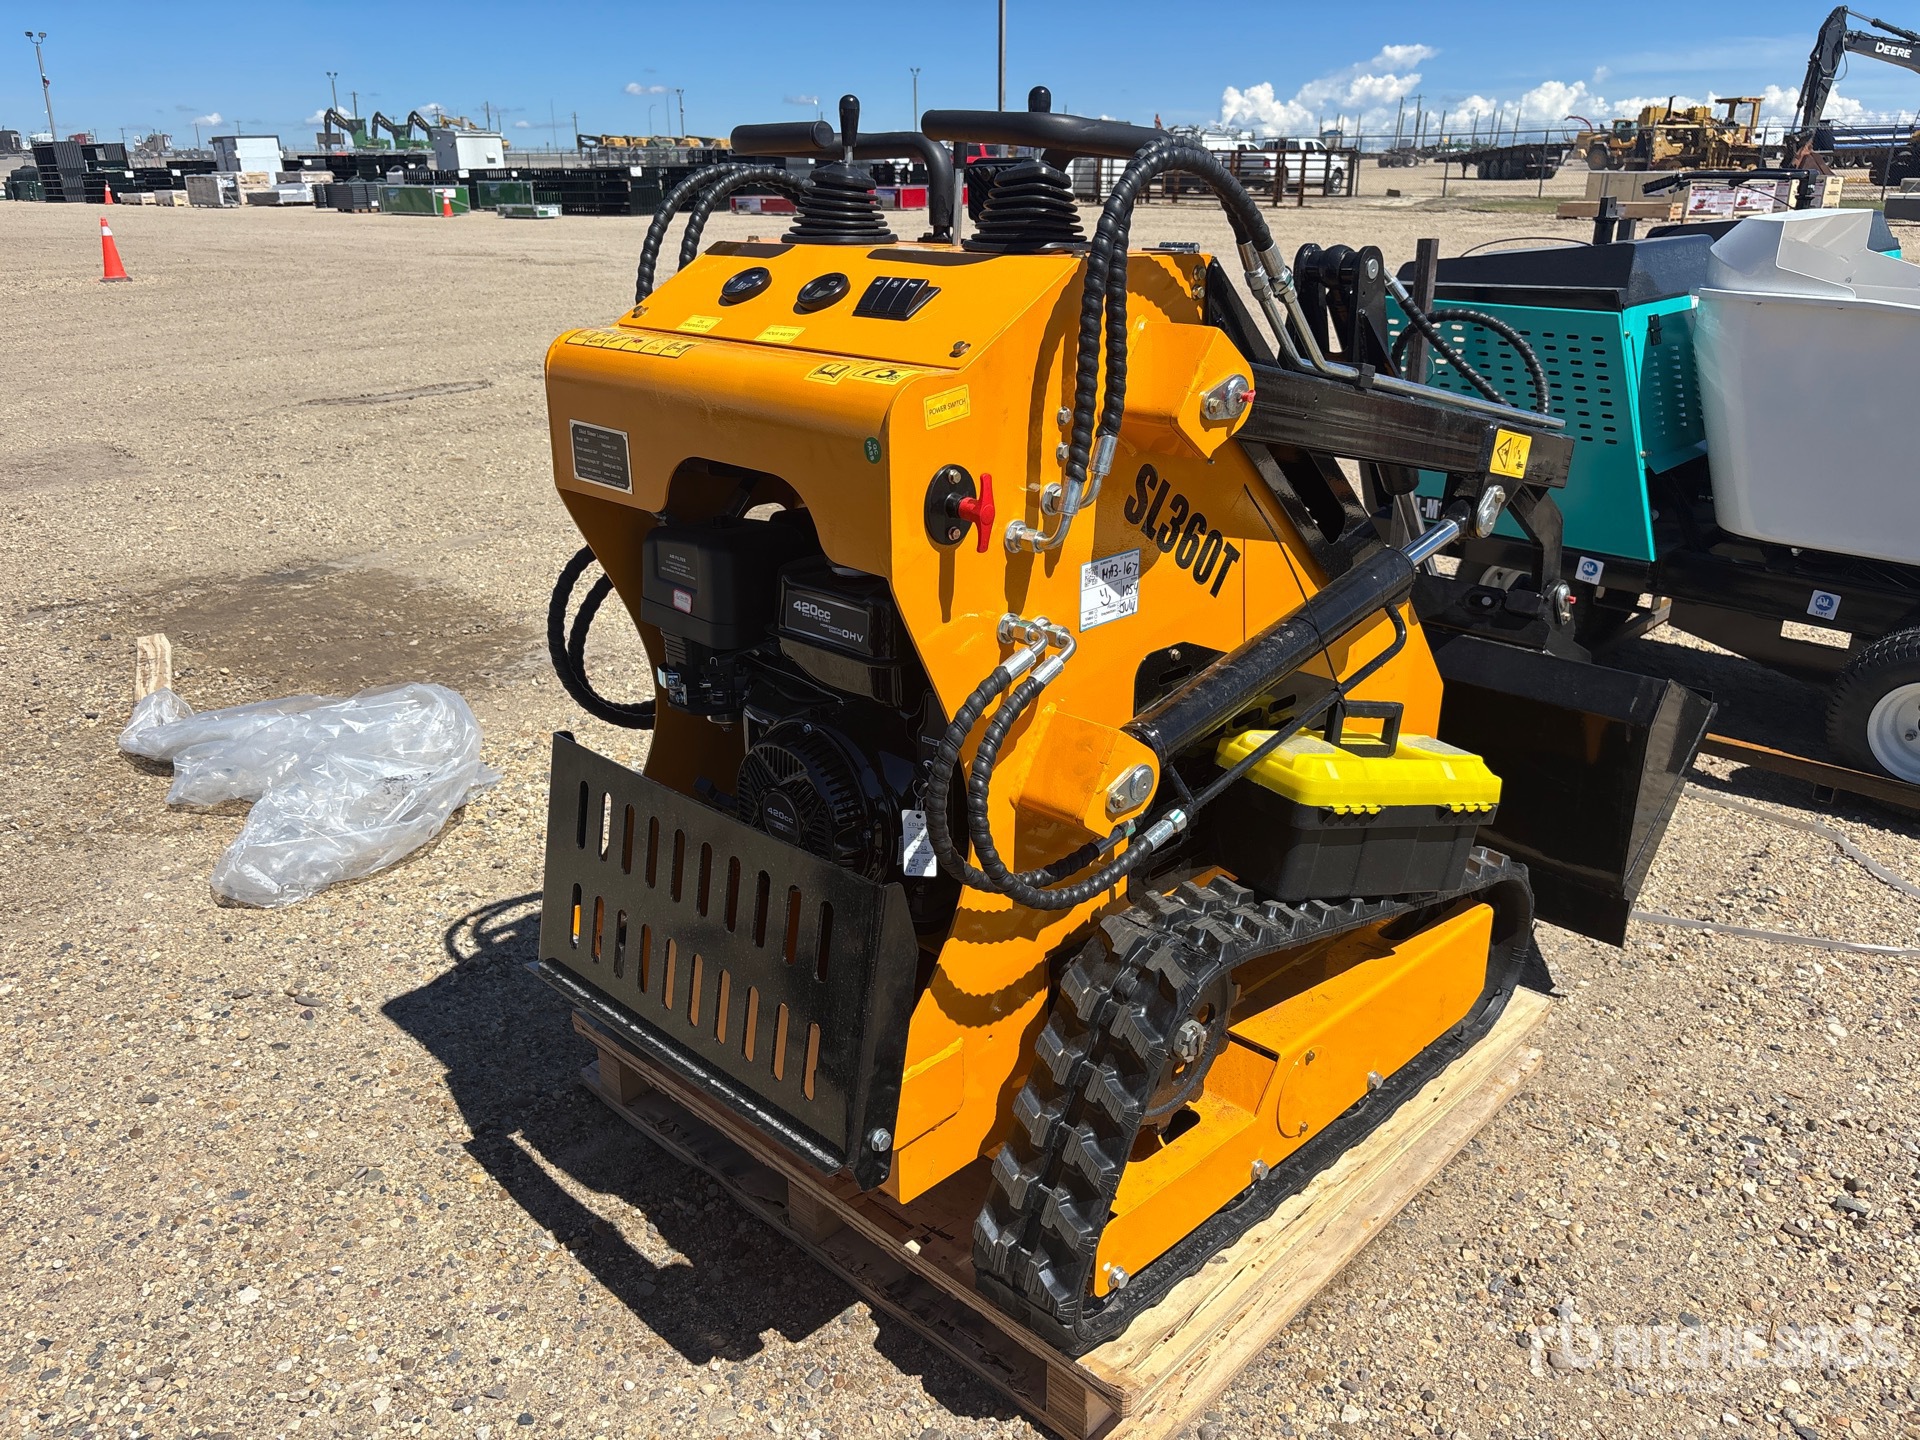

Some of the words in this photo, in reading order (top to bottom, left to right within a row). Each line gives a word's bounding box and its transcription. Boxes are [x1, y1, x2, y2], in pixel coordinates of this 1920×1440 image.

[1875, 42, 1912, 58] DEERE
[928, 404, 947, 415] POWER
[947, 398, 966, 410] SWITCH
[866, 440, 875, 461] PASS
[872, 443, 879, 456] QC
[1123, 463, 1241, 598] SL360T
[793, 600, 831, 619] 420cc
[841, 629, 864, 643] OHV
[767, 807, 794, 824] 420cc
